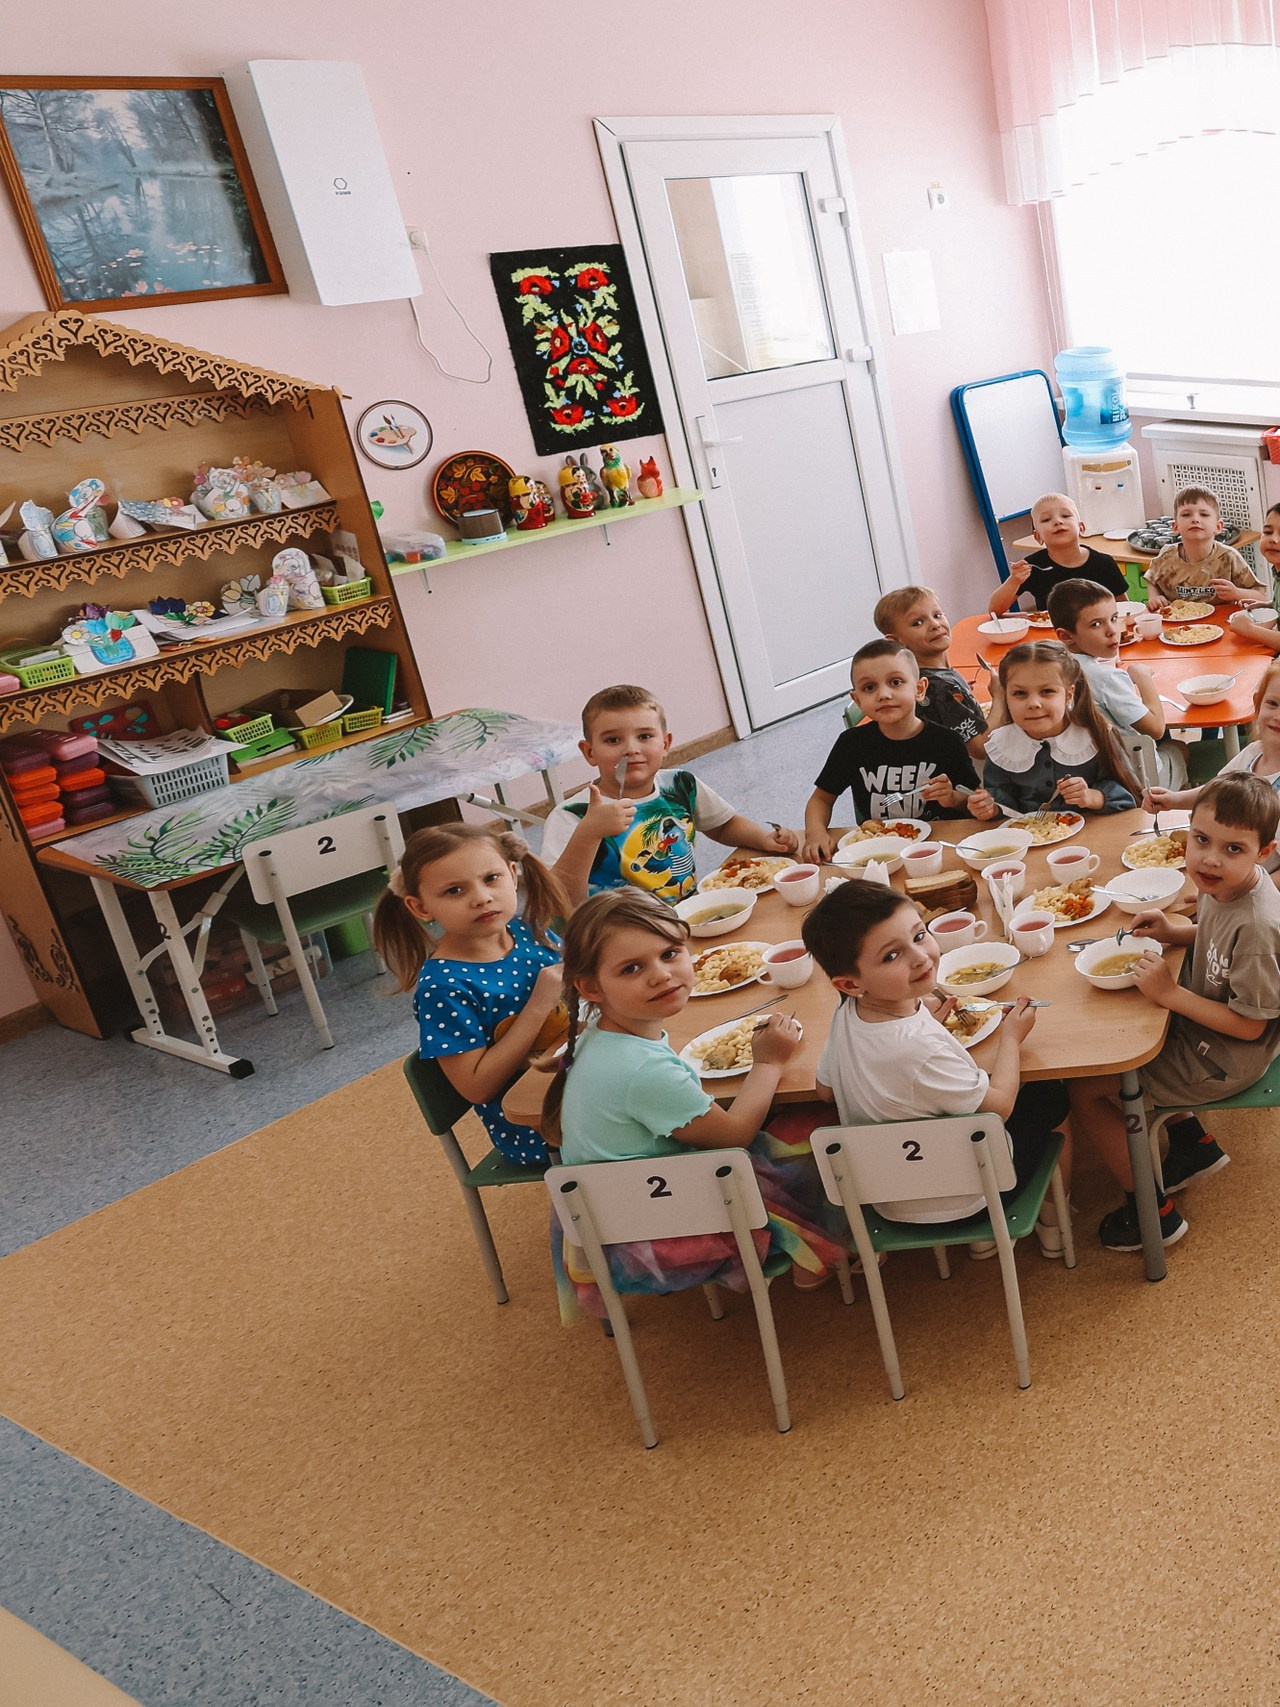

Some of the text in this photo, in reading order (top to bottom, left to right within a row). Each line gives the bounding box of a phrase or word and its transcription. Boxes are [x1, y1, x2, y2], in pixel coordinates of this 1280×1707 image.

[859, 762, 937, 793] WEEK
[870, 792, 927, 820] END
[317, 835, 337, 855] 2
[1125, 1113, 1143, 1134] 2
[902, 1140, 924, 1161] 2
[646, 1175, 673, 1198] 2
